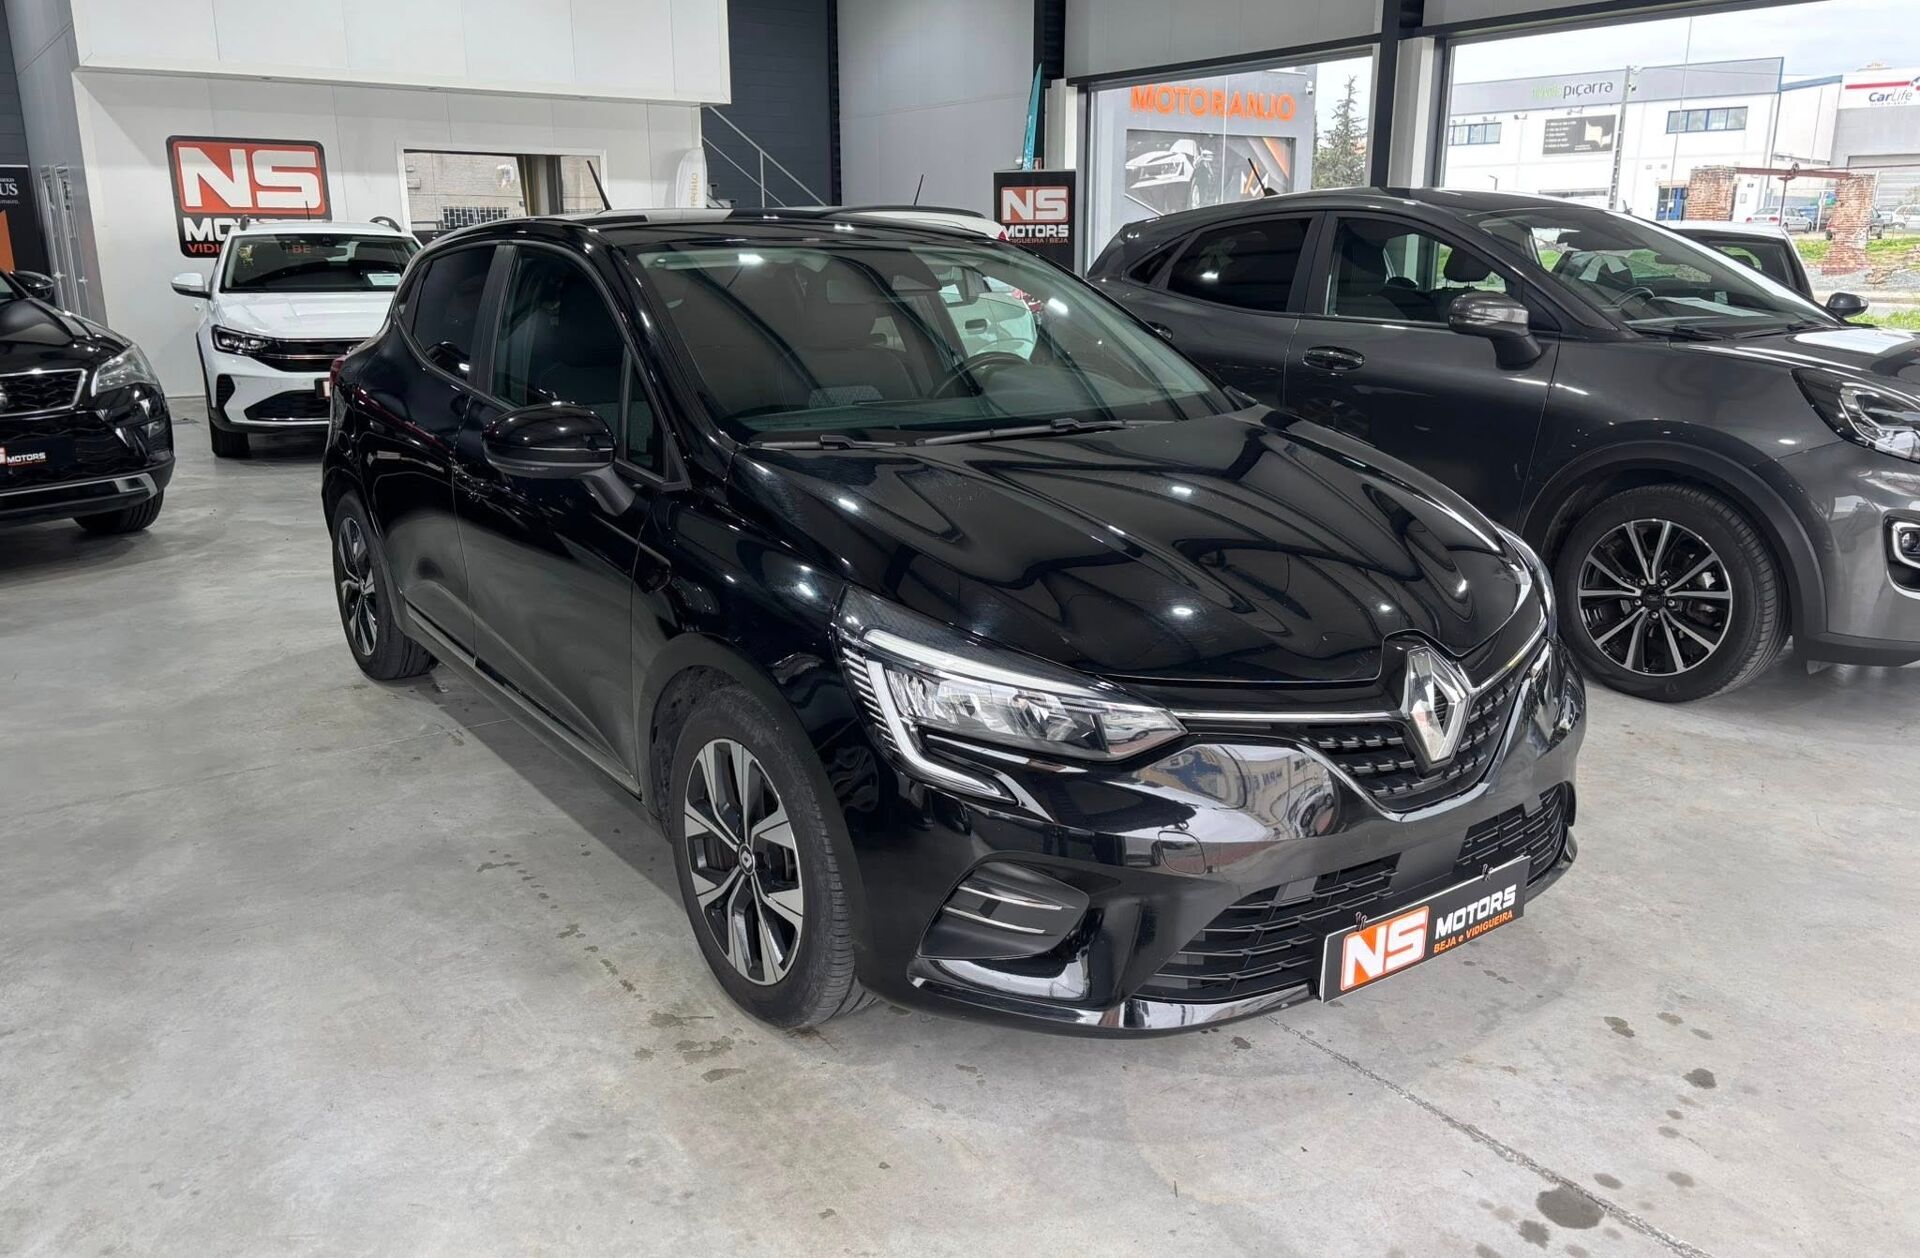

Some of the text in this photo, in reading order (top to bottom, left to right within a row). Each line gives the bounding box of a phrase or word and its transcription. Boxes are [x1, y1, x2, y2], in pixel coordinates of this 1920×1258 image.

[1131, 84, 1296, 121] MOTORANJO
[178, 147, 320, 208] NS
[1003, 189, 1067, 220] NS
[7, 452, 46, 463] MOTORS
[1343, 884, 1517, 990] NS MOTORS
[1433, 938, 1457, 954] BEJA
[1466, 909, 1513, 938] VIDIGUEIRA
